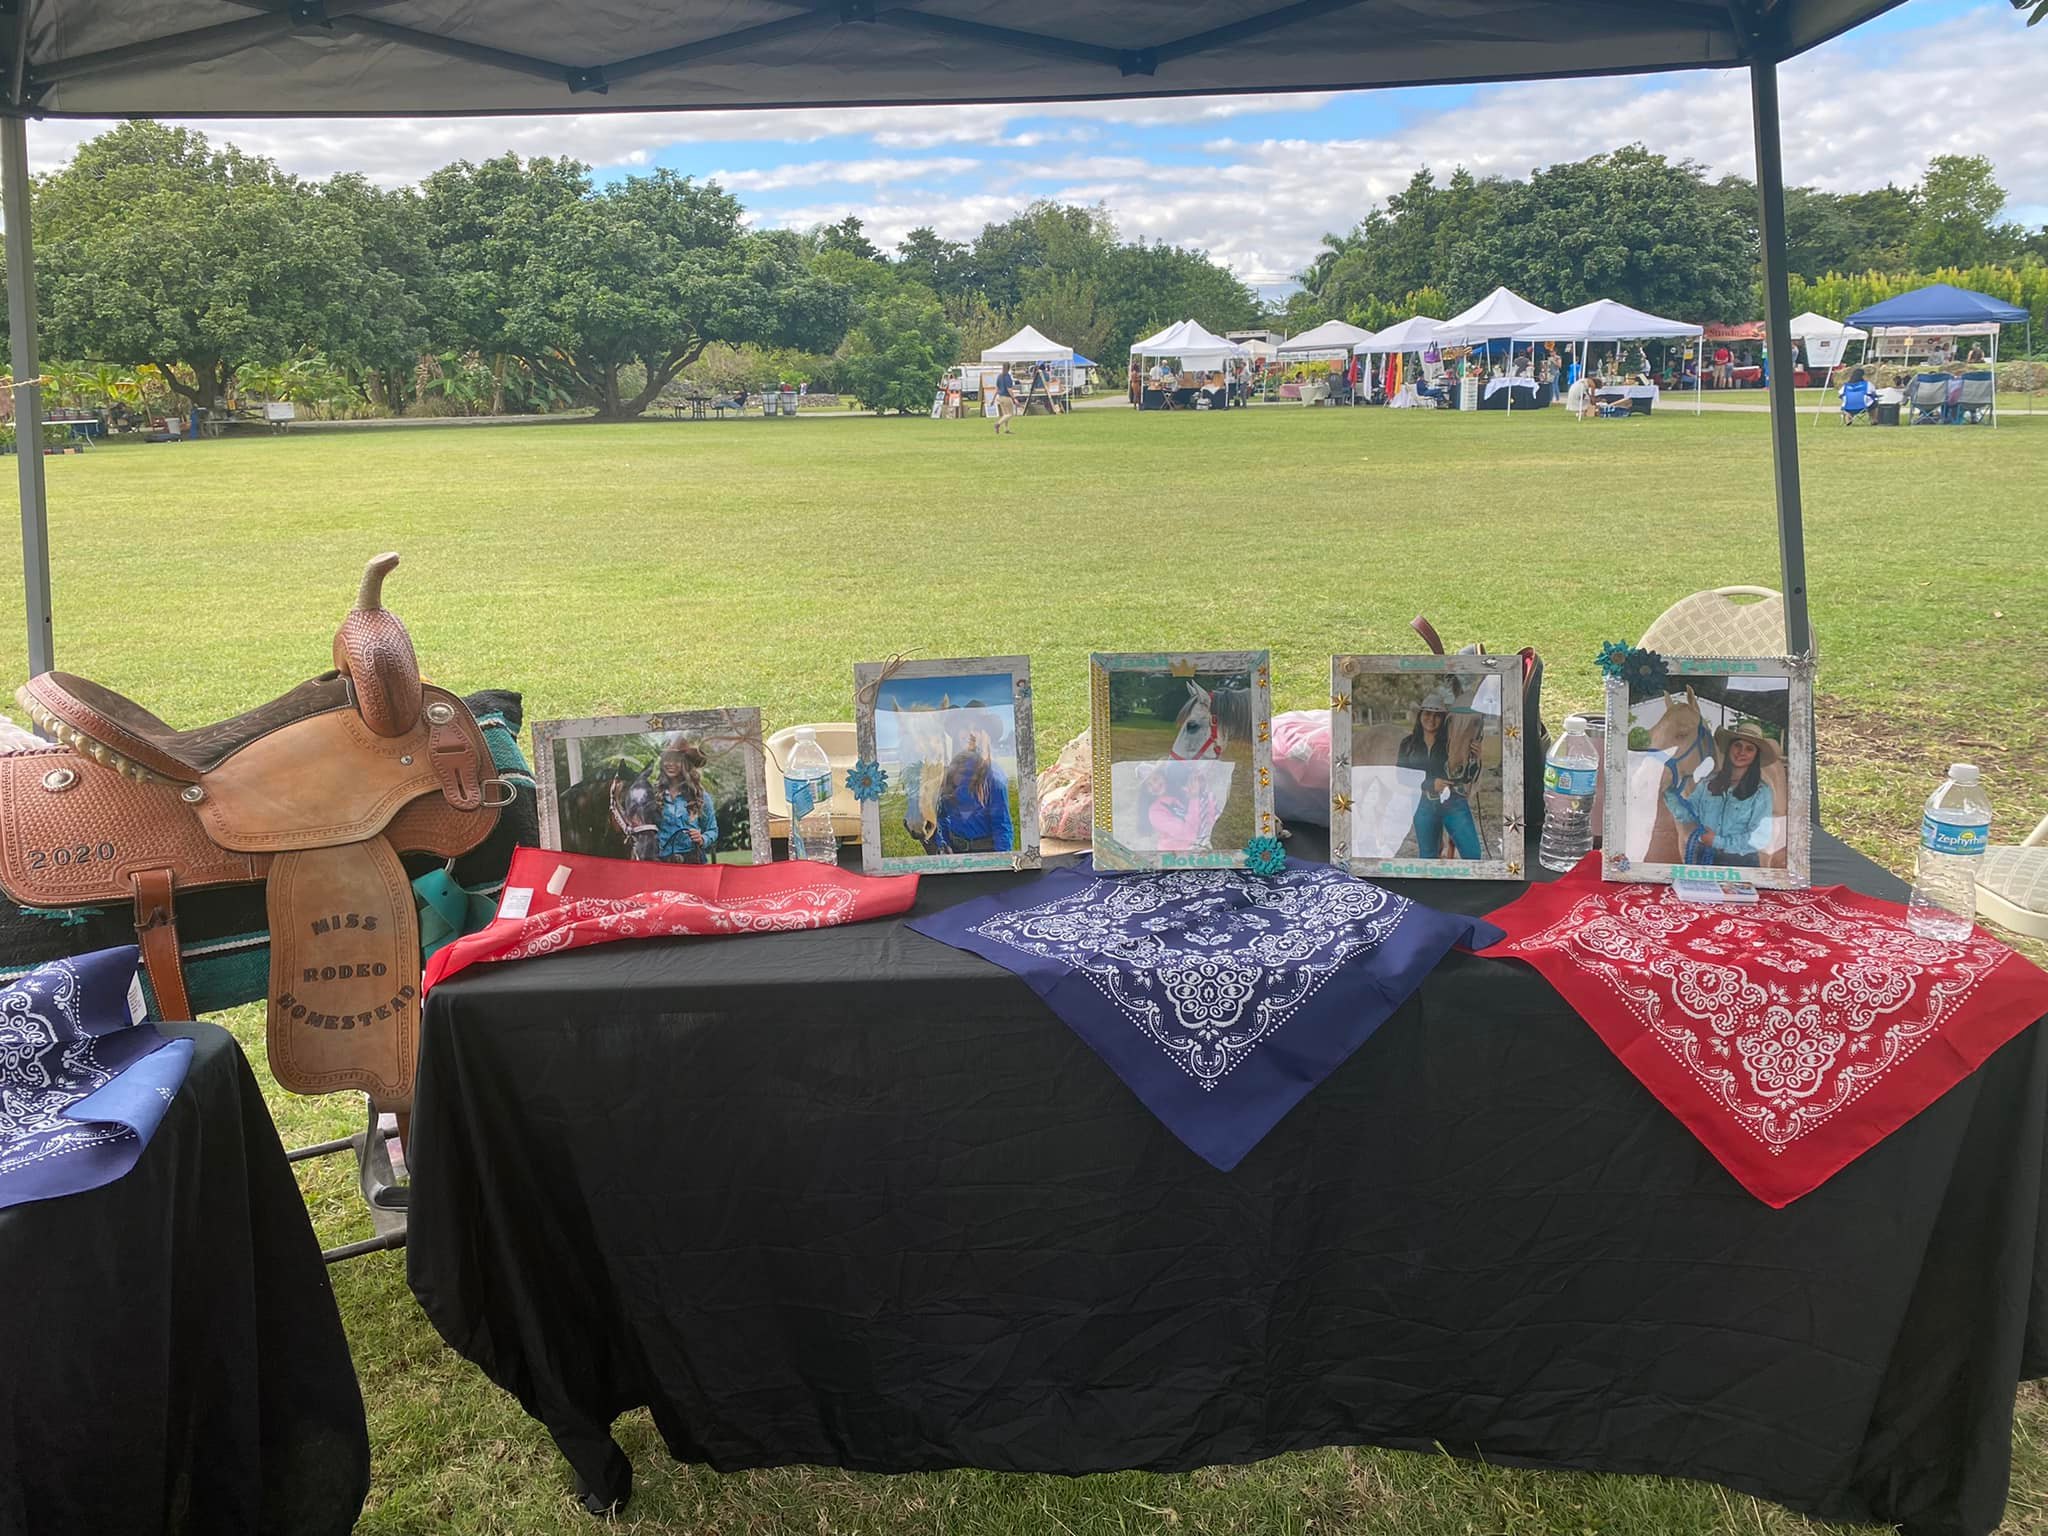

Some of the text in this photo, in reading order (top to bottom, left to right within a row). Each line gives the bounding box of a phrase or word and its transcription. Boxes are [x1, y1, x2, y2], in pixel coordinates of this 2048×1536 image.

[28, 843, 115, 869] 2020
[1671, 865, 1741, 881] Housh
[311, 913, 378, 936] MISS
[303, 962, 387, 982] RODEO
[277, 984, 415, 1030] HOMESTEAD
